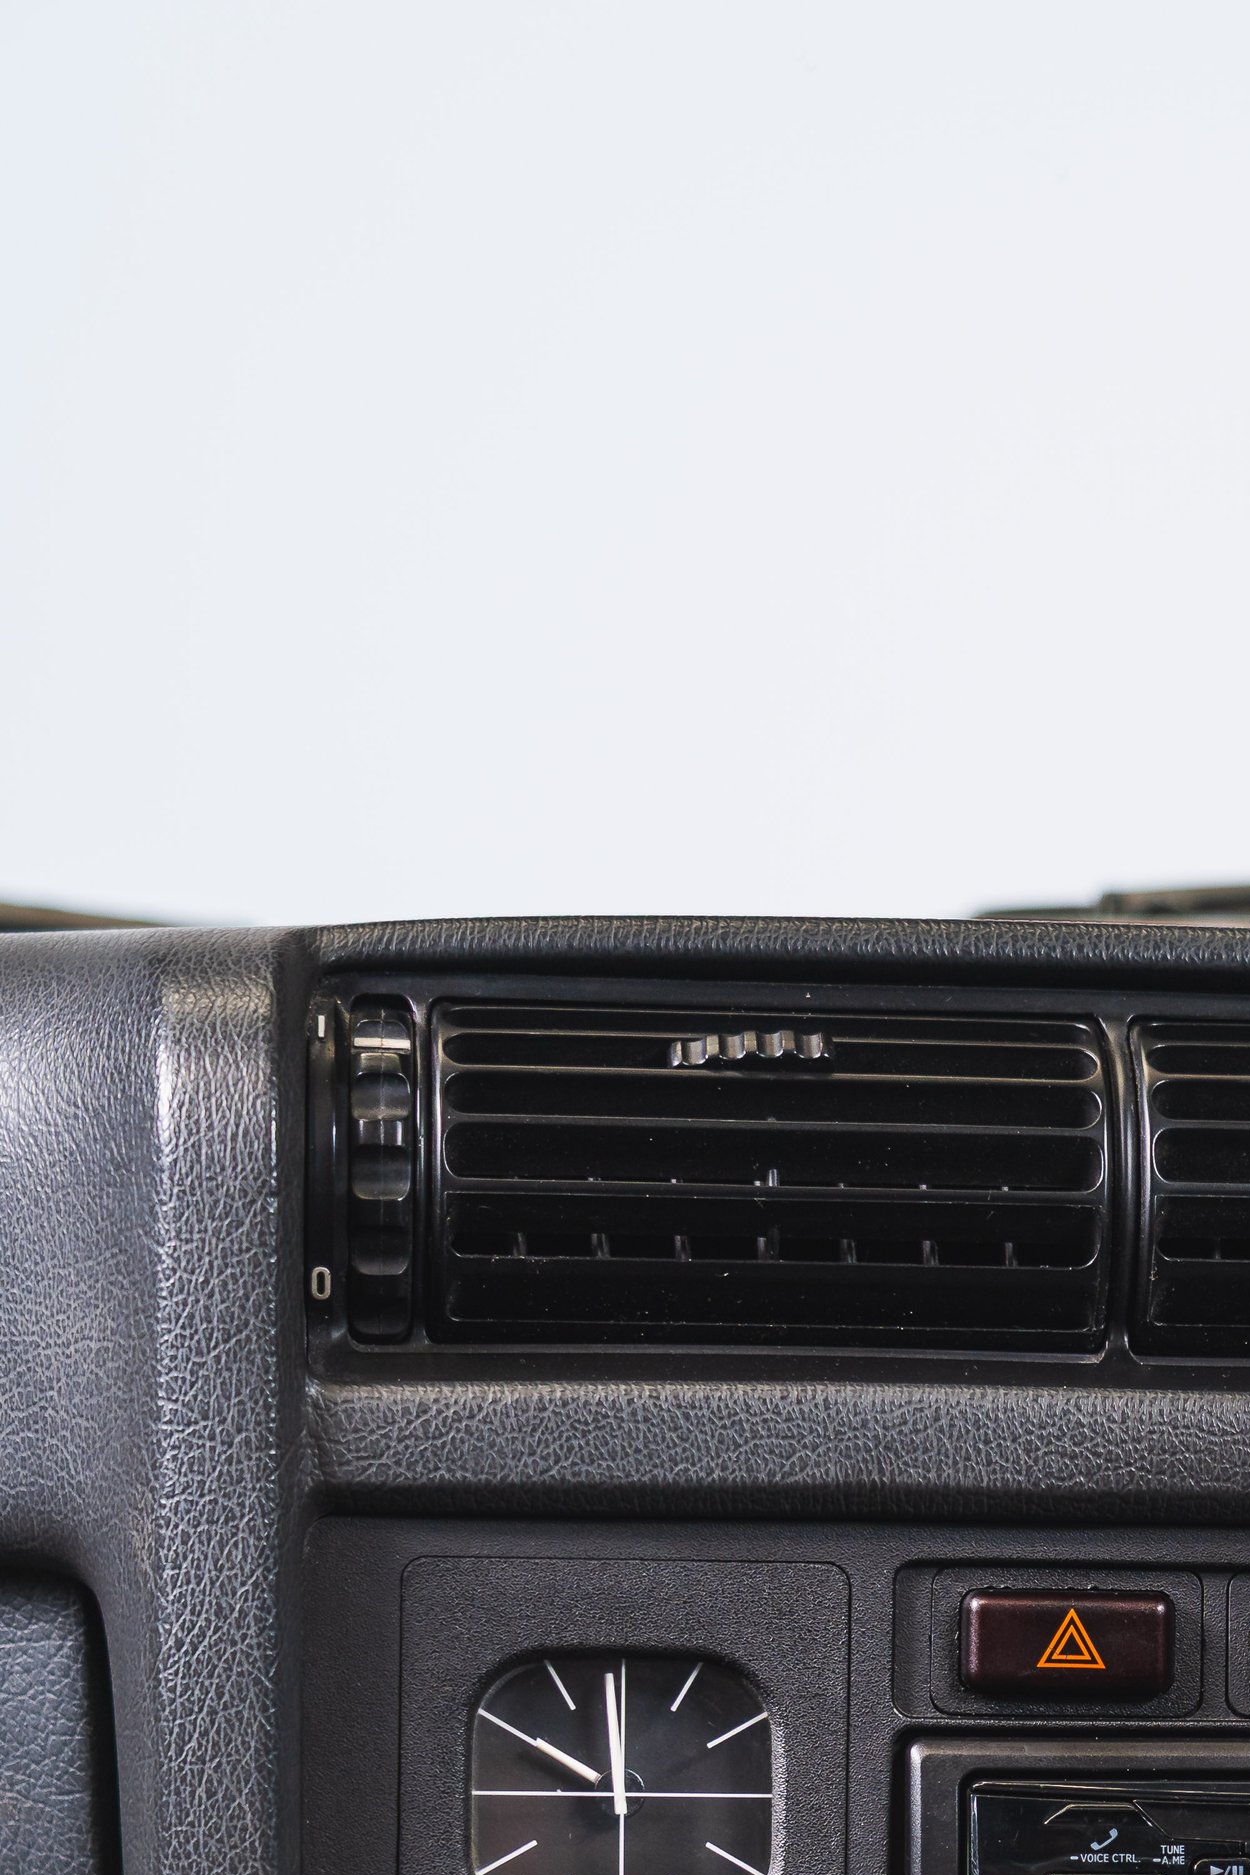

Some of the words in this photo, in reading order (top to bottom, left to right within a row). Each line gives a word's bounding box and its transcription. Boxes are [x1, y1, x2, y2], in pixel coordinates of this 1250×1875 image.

[1161, 1845, 1185, 1855] TUNE
[1080, 1853, 1109, 1863] VOICE
[1112, 1853, 1141, 1863] CTRL.
[1161, 1855, 1186, 1865] A.ME
